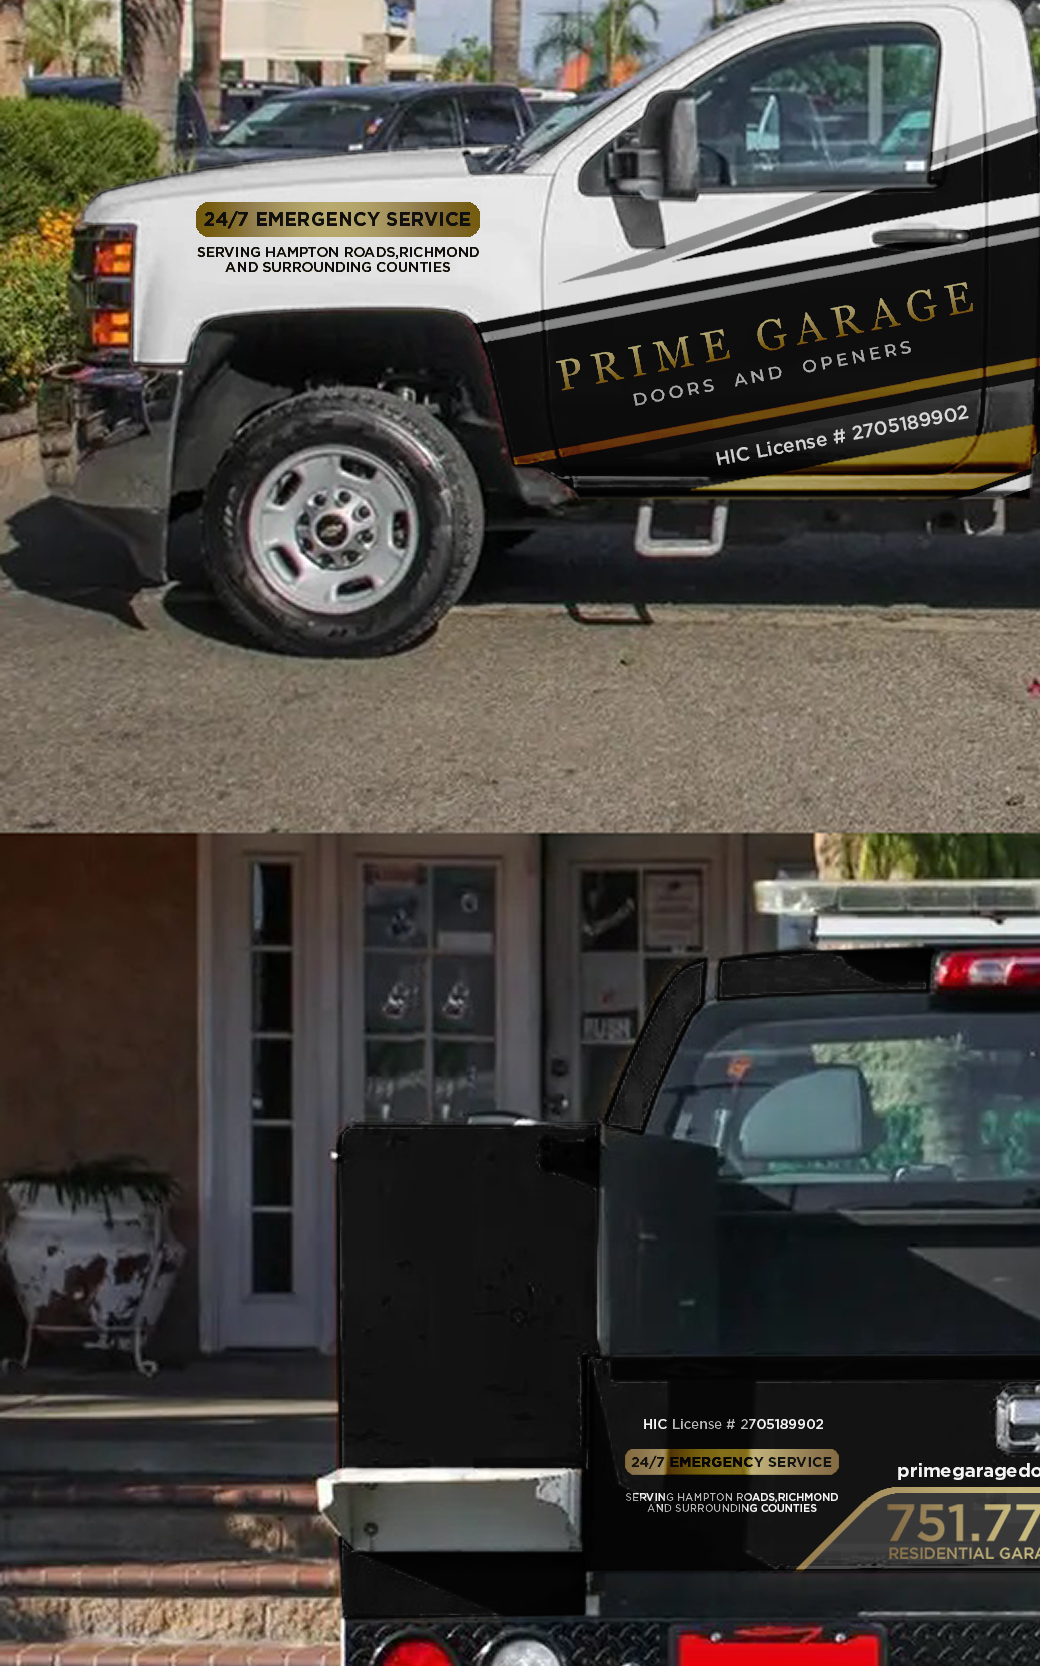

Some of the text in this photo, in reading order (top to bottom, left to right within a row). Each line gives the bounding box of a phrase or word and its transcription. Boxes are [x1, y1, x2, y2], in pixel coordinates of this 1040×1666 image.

[204, 211, 470, 228] 24/7 EMERGENCY SERVICE
[198, 247, 260, 257] SERVING
[266, 247, 338, 257] HAMPTON
[225, 262, 450, 272] AND SURROUNDING COUNTIES
[556, 281, 976, 391] PRIME GARAGE
[633, 341, 911, 406] DOORS AND OPENERS
[716, 405, 969, 465] HIC License # 2705189902
[644, 1419, 823, 1429] HIC License # 2705189902
[632, 1456, 831, 1469] 24/7 EMERGENCY SERVICE
[626, 1493, 673, 1501] SERVING
[678, 1493, 732, 1501] HAMPTON
[648, 1504, 817, 1512] AND SURROUNDING COUNTIES
[890, 1547, 994, 1559] RESIDENTIAL
